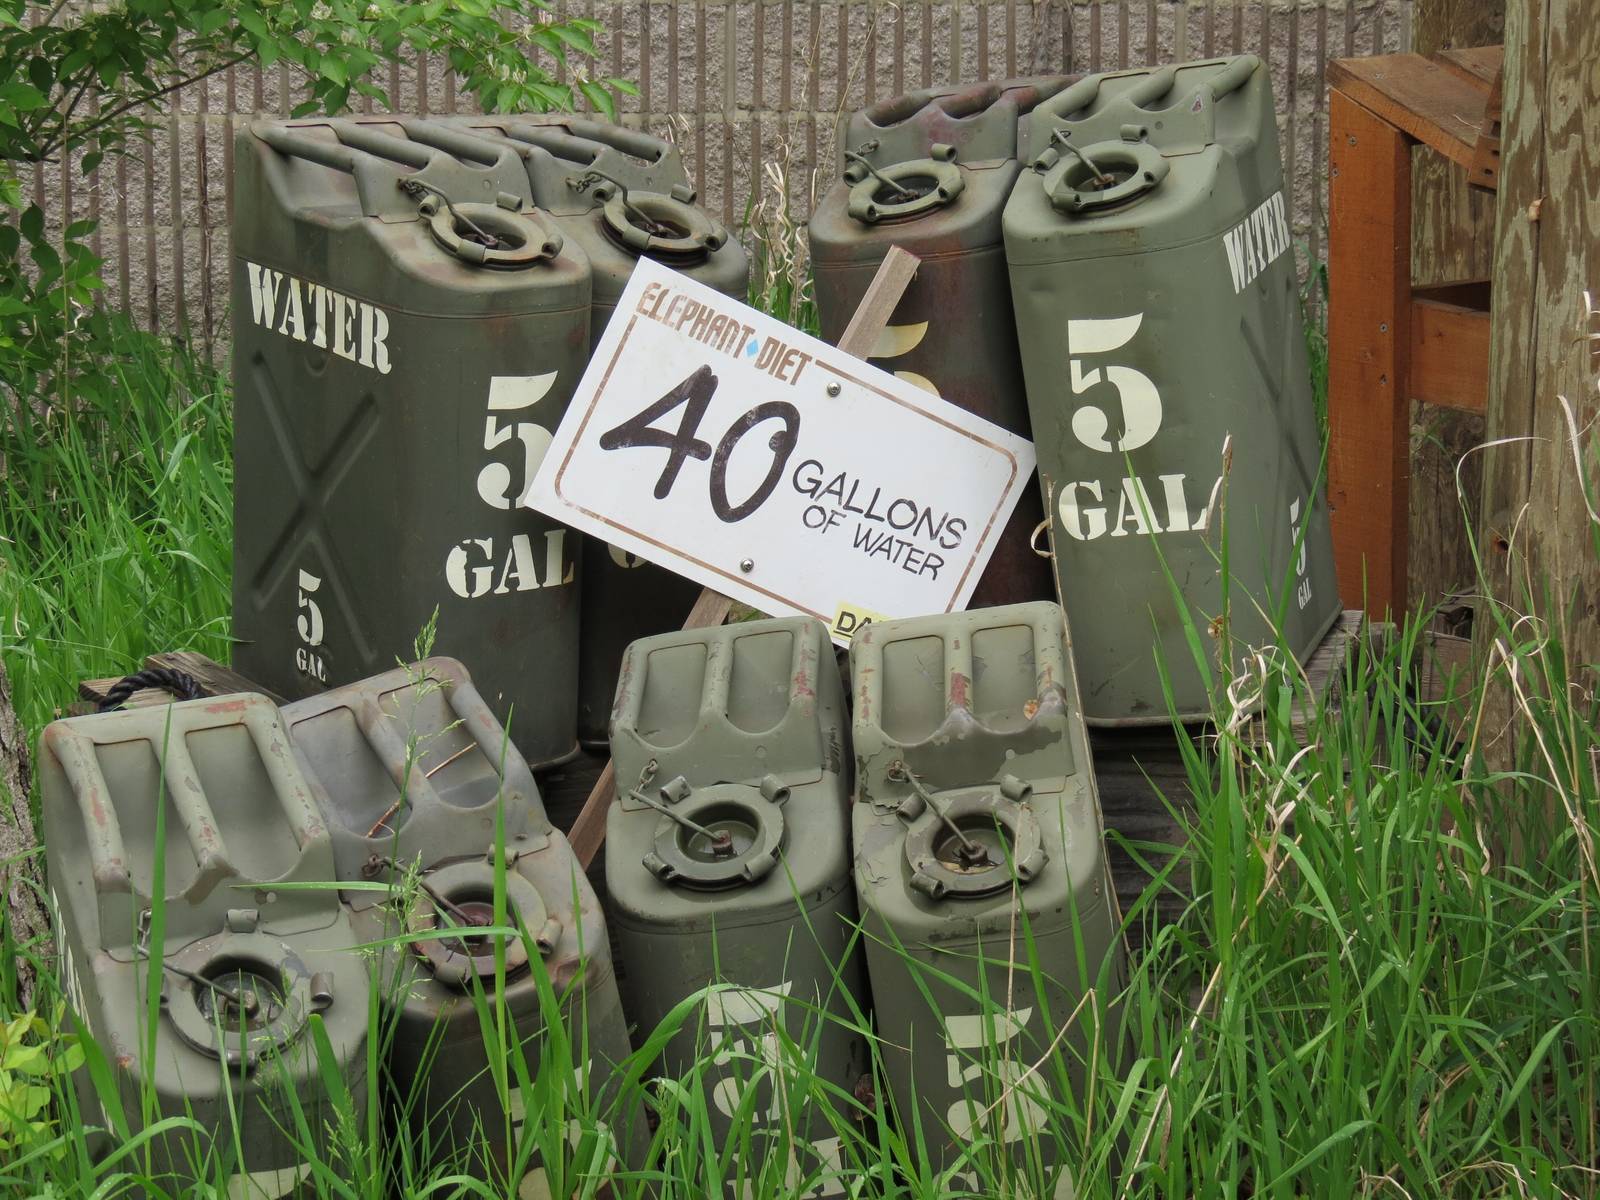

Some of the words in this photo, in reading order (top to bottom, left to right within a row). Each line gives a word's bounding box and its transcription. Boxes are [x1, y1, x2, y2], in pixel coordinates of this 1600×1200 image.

[1223, 191, 1290, 295] WATER
[247, 261, 392, 375] WATER
[636, 282, 756, 359] ELEPHANT
[754, 336, 812, 385] DIET
[1068, 312, 1163, 453] 5
[477, 370, 558, 510] 5
[600, 364, 801, 523] 40
[792, 459, 967, 549] GALLONS
[803, 505, 847, 534] OF
[853, 523, 945, 581] WATER
[1058, 473, 1208, 541] GAL
[297, 568, 324, 646] 5
[445, 529, 575, 598] GAL
[296, 647, 327, 682] GAL
[707, 980, 807, 1124] 5
[945, 1006, 1050, 1144] 5
